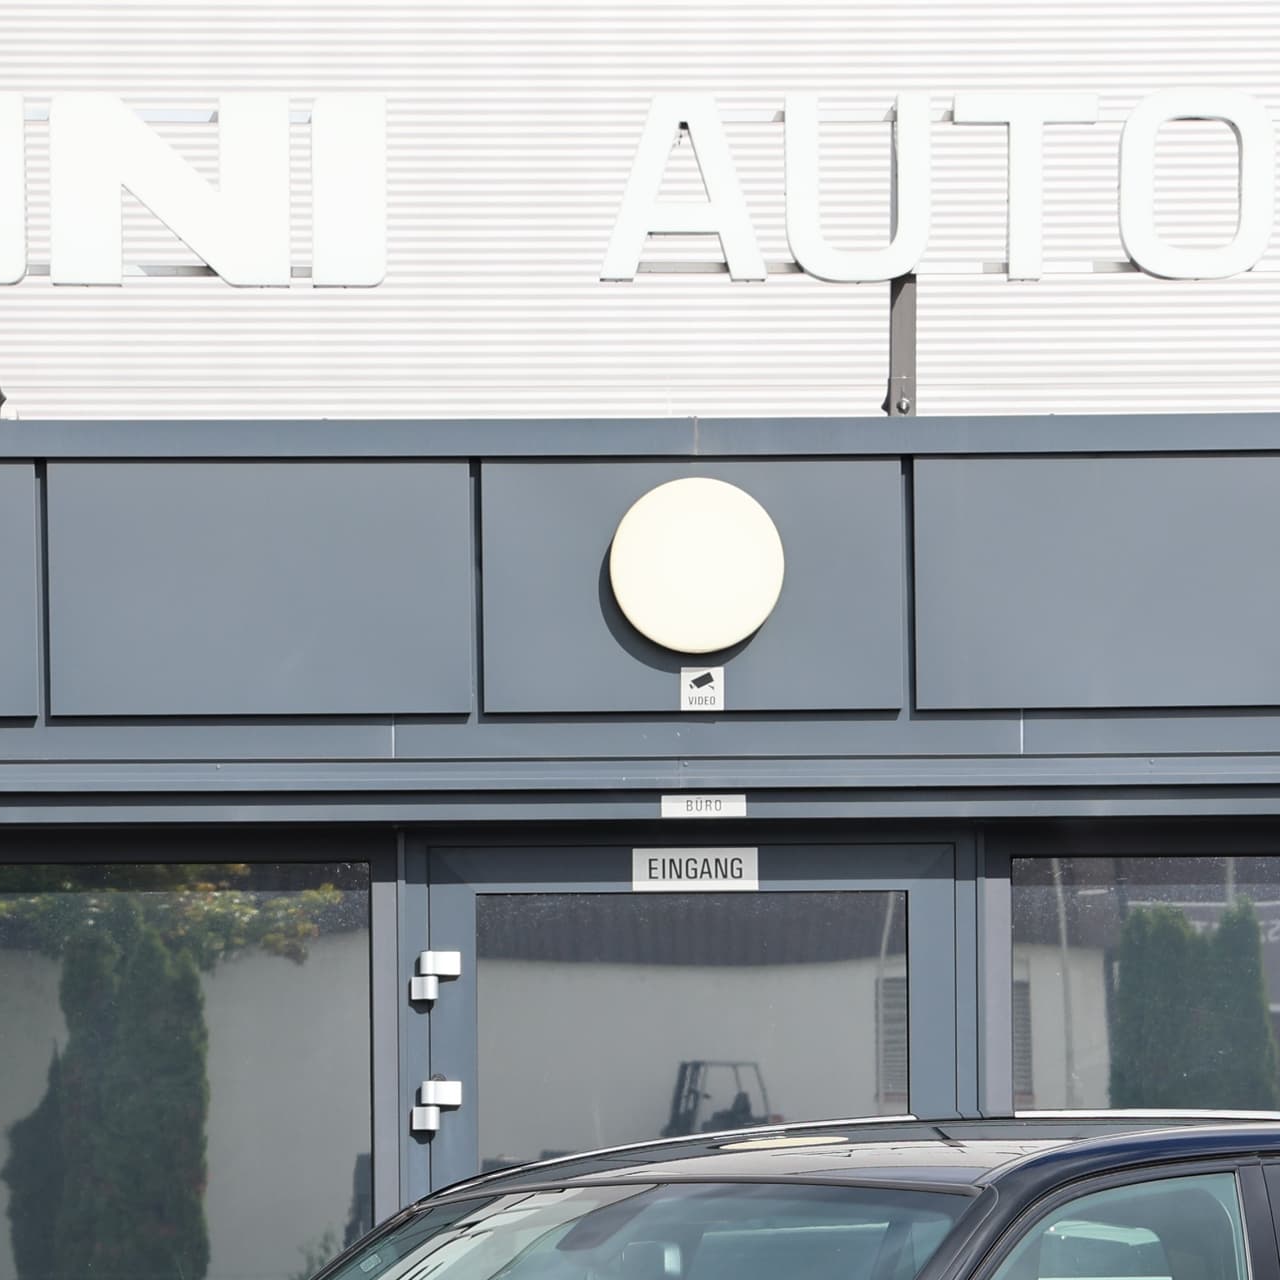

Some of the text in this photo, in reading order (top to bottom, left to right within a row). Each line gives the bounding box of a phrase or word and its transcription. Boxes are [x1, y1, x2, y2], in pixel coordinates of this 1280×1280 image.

[598, 87, 1276, 283] AUTO
[688, 695, 716, 705] VIDEO
[685, 796, 723, 812] BÜRO
[647, 857, 744, 880] EINGANG
